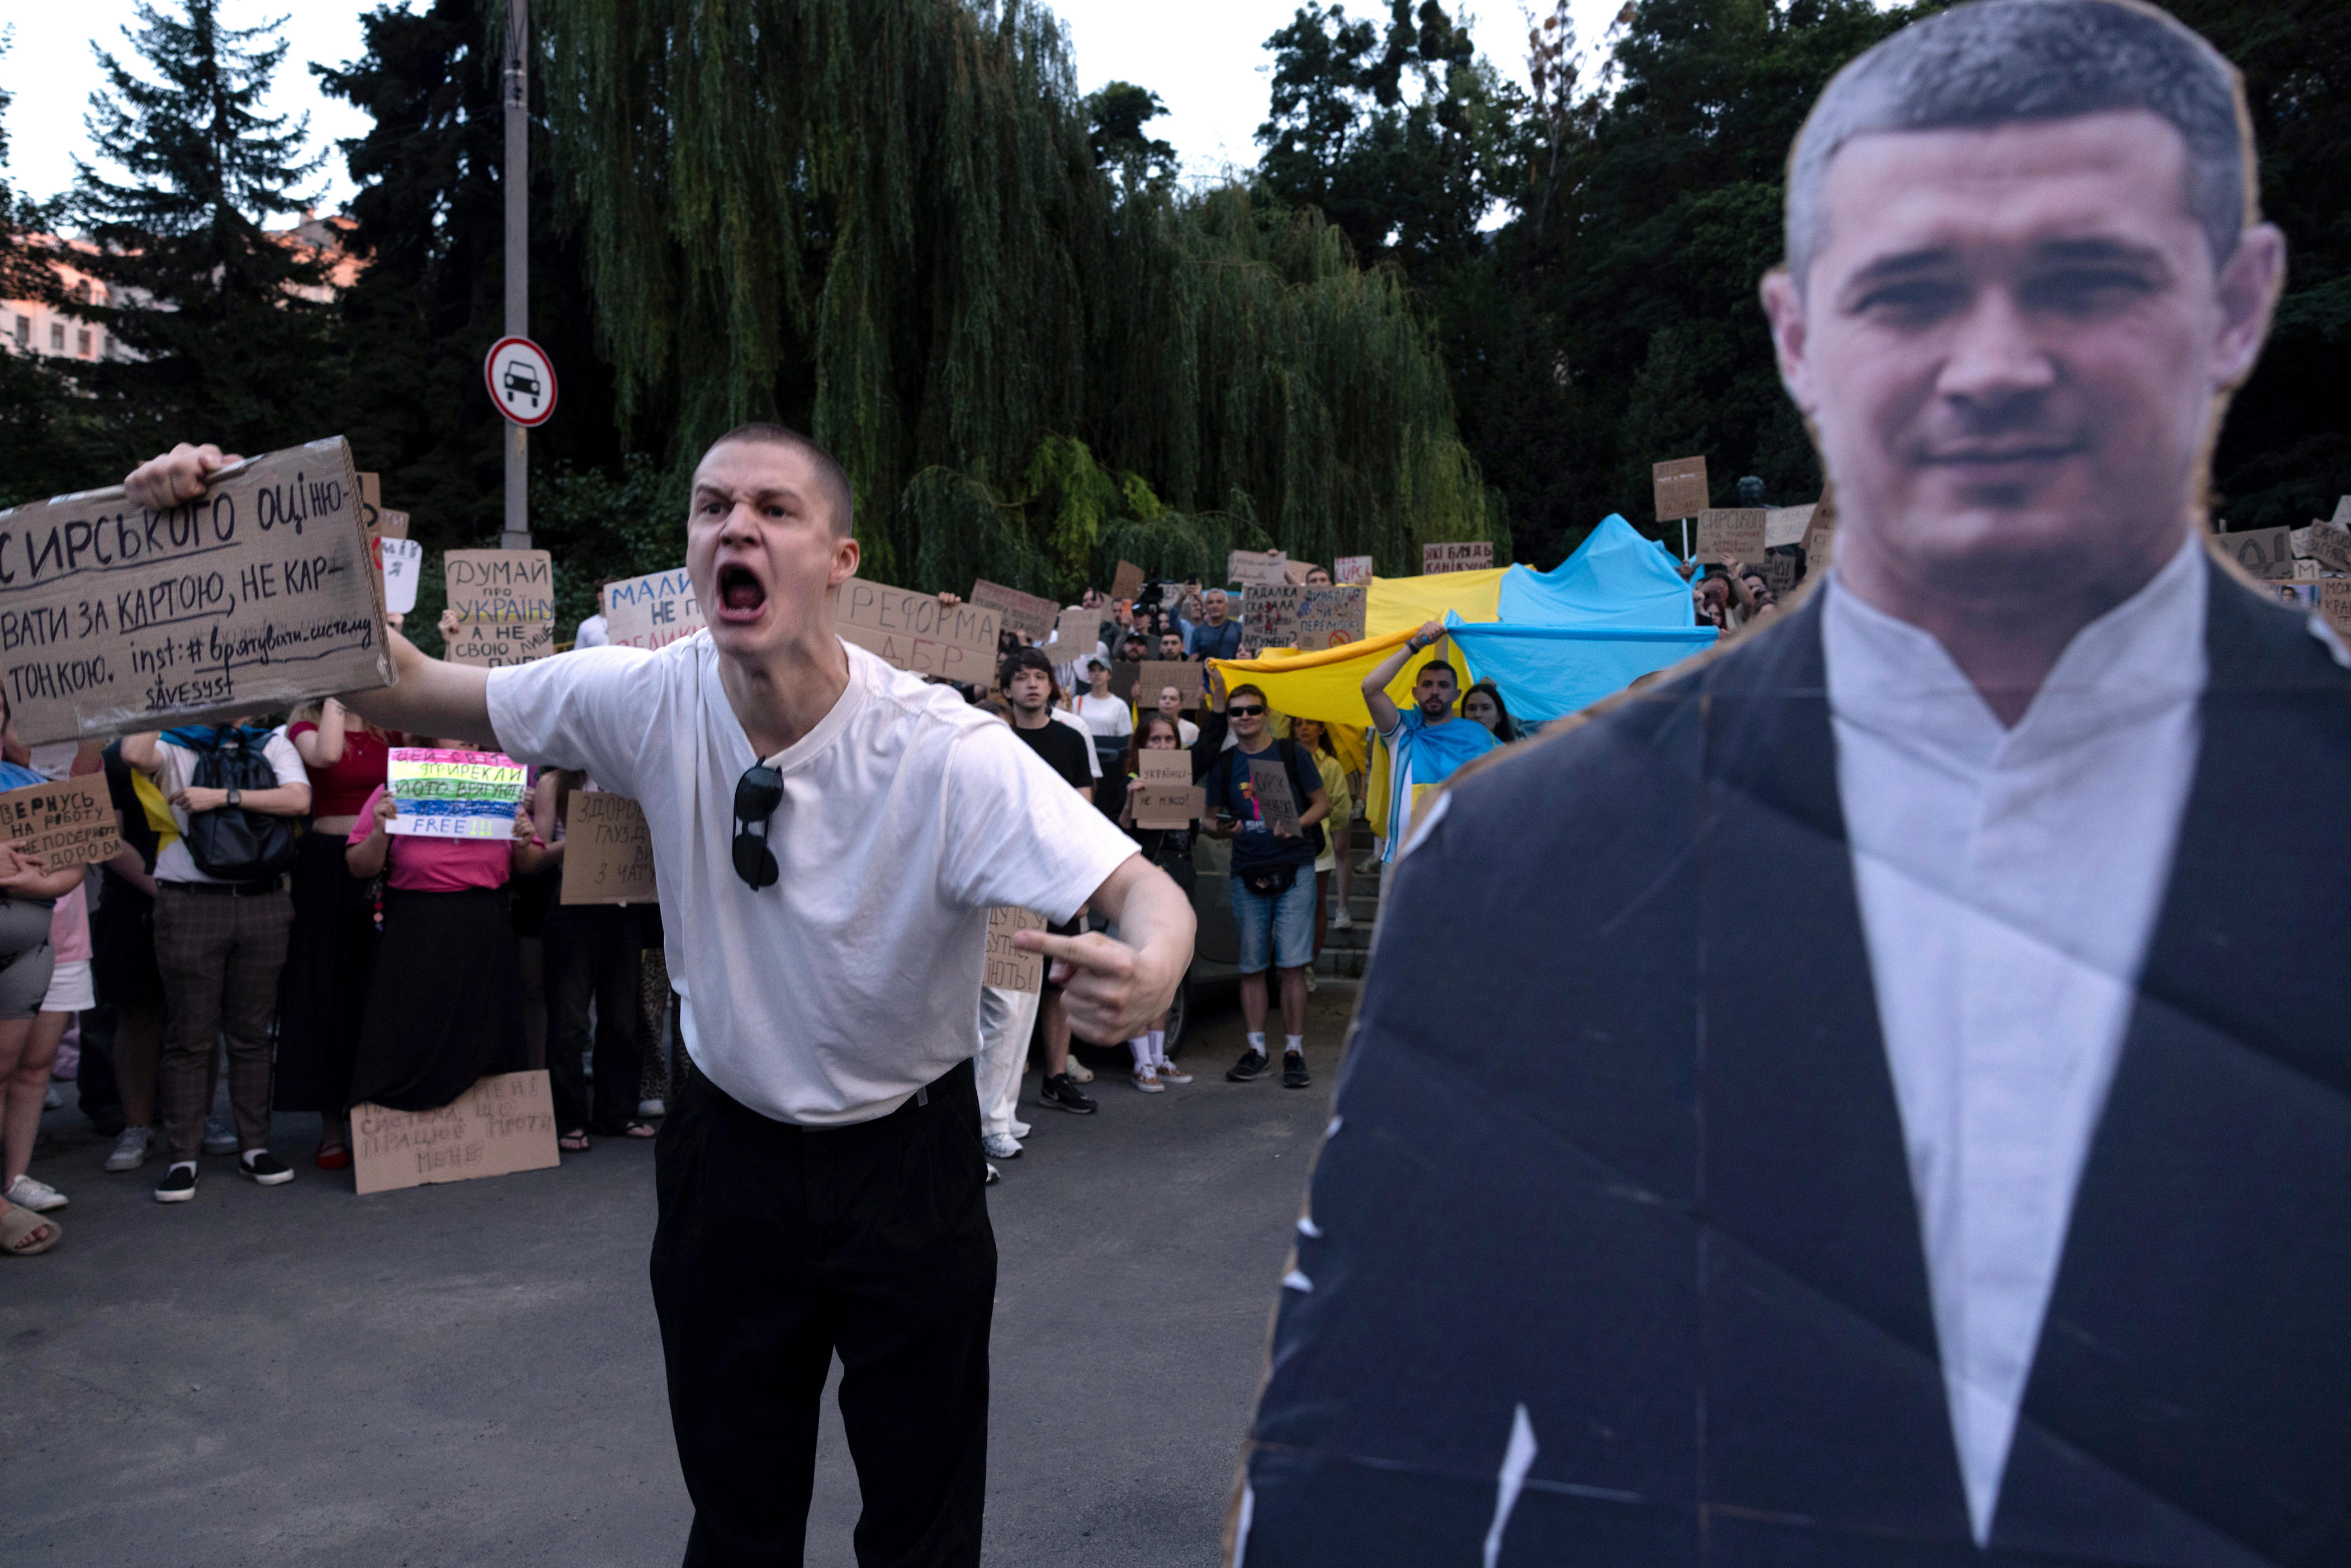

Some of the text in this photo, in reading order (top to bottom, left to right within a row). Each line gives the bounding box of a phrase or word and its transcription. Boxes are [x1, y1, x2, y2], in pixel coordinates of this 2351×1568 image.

[0, 492, 235, 584] СИРСЬКОГО
[1448, 545, 1491, 558] БЛЯДЬ
[448, 558, 548, 586] ДУМАЙ
[1, 556, 344, 652] ВАТИ ЗА КАРТОЮ, НЕ КАР-
[483, 588, 512, 596] ПРО
[612, 573, 690, 610] МАЛИ
[1246, 587, 1298, 599] ГАДАЛКА
[456, 594, 555, 623] УКРАЇНУ
[651, 600, 676, 625] НЕ
[850, 586, 994, 646] РЕФОРМА
[1246, 600, 1295, 613] СКАЗАЛА
[472, 626, 526, 640] А НЕ
[456, 642, 509, 657] СВОЮ
[881, 636, 963, 674] ДБР
[8, 655, 113, 703] ТОНКОЮ.
[11, 808, 103, 839] НА РОБОТУ
[50, 839, 121, 870] ДОРОВА
[593, 862, 608, 884] З
[988, 905, 1025, 929] ДУТЬ
[986, 958, 1033, 990] ІЮТЬ!
[417, 1143, 483, 1173] МЕНЕ
